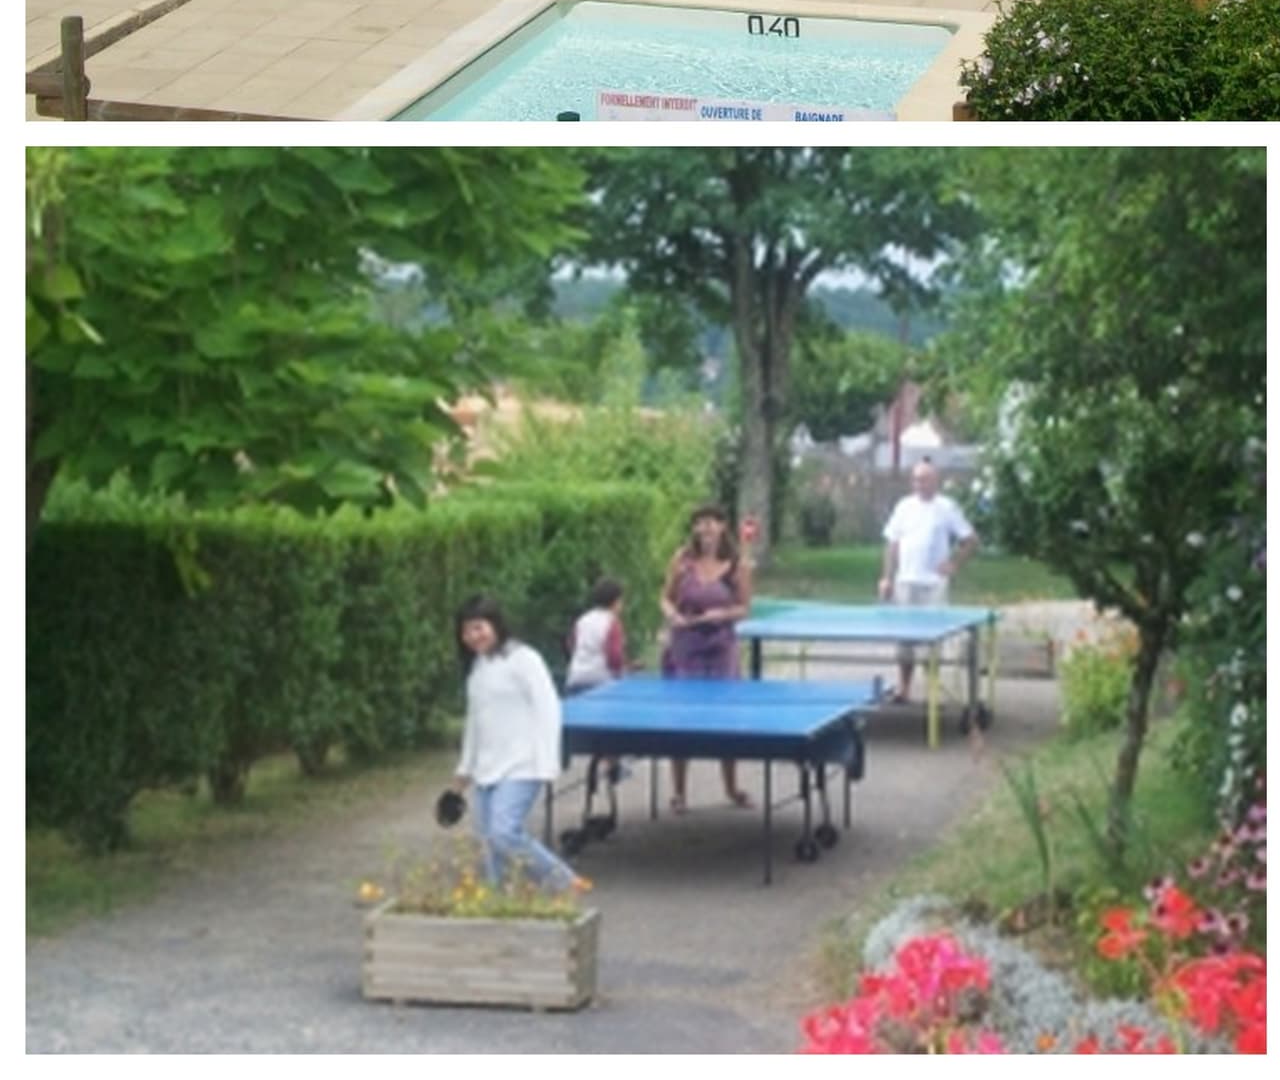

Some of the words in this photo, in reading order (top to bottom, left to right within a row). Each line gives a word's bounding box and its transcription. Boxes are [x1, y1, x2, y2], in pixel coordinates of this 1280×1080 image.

[748, 15, 800, 38] 0.40
[700, 106, 750, 120] OUVERTURE
[752, 108, 763, 120] DE
